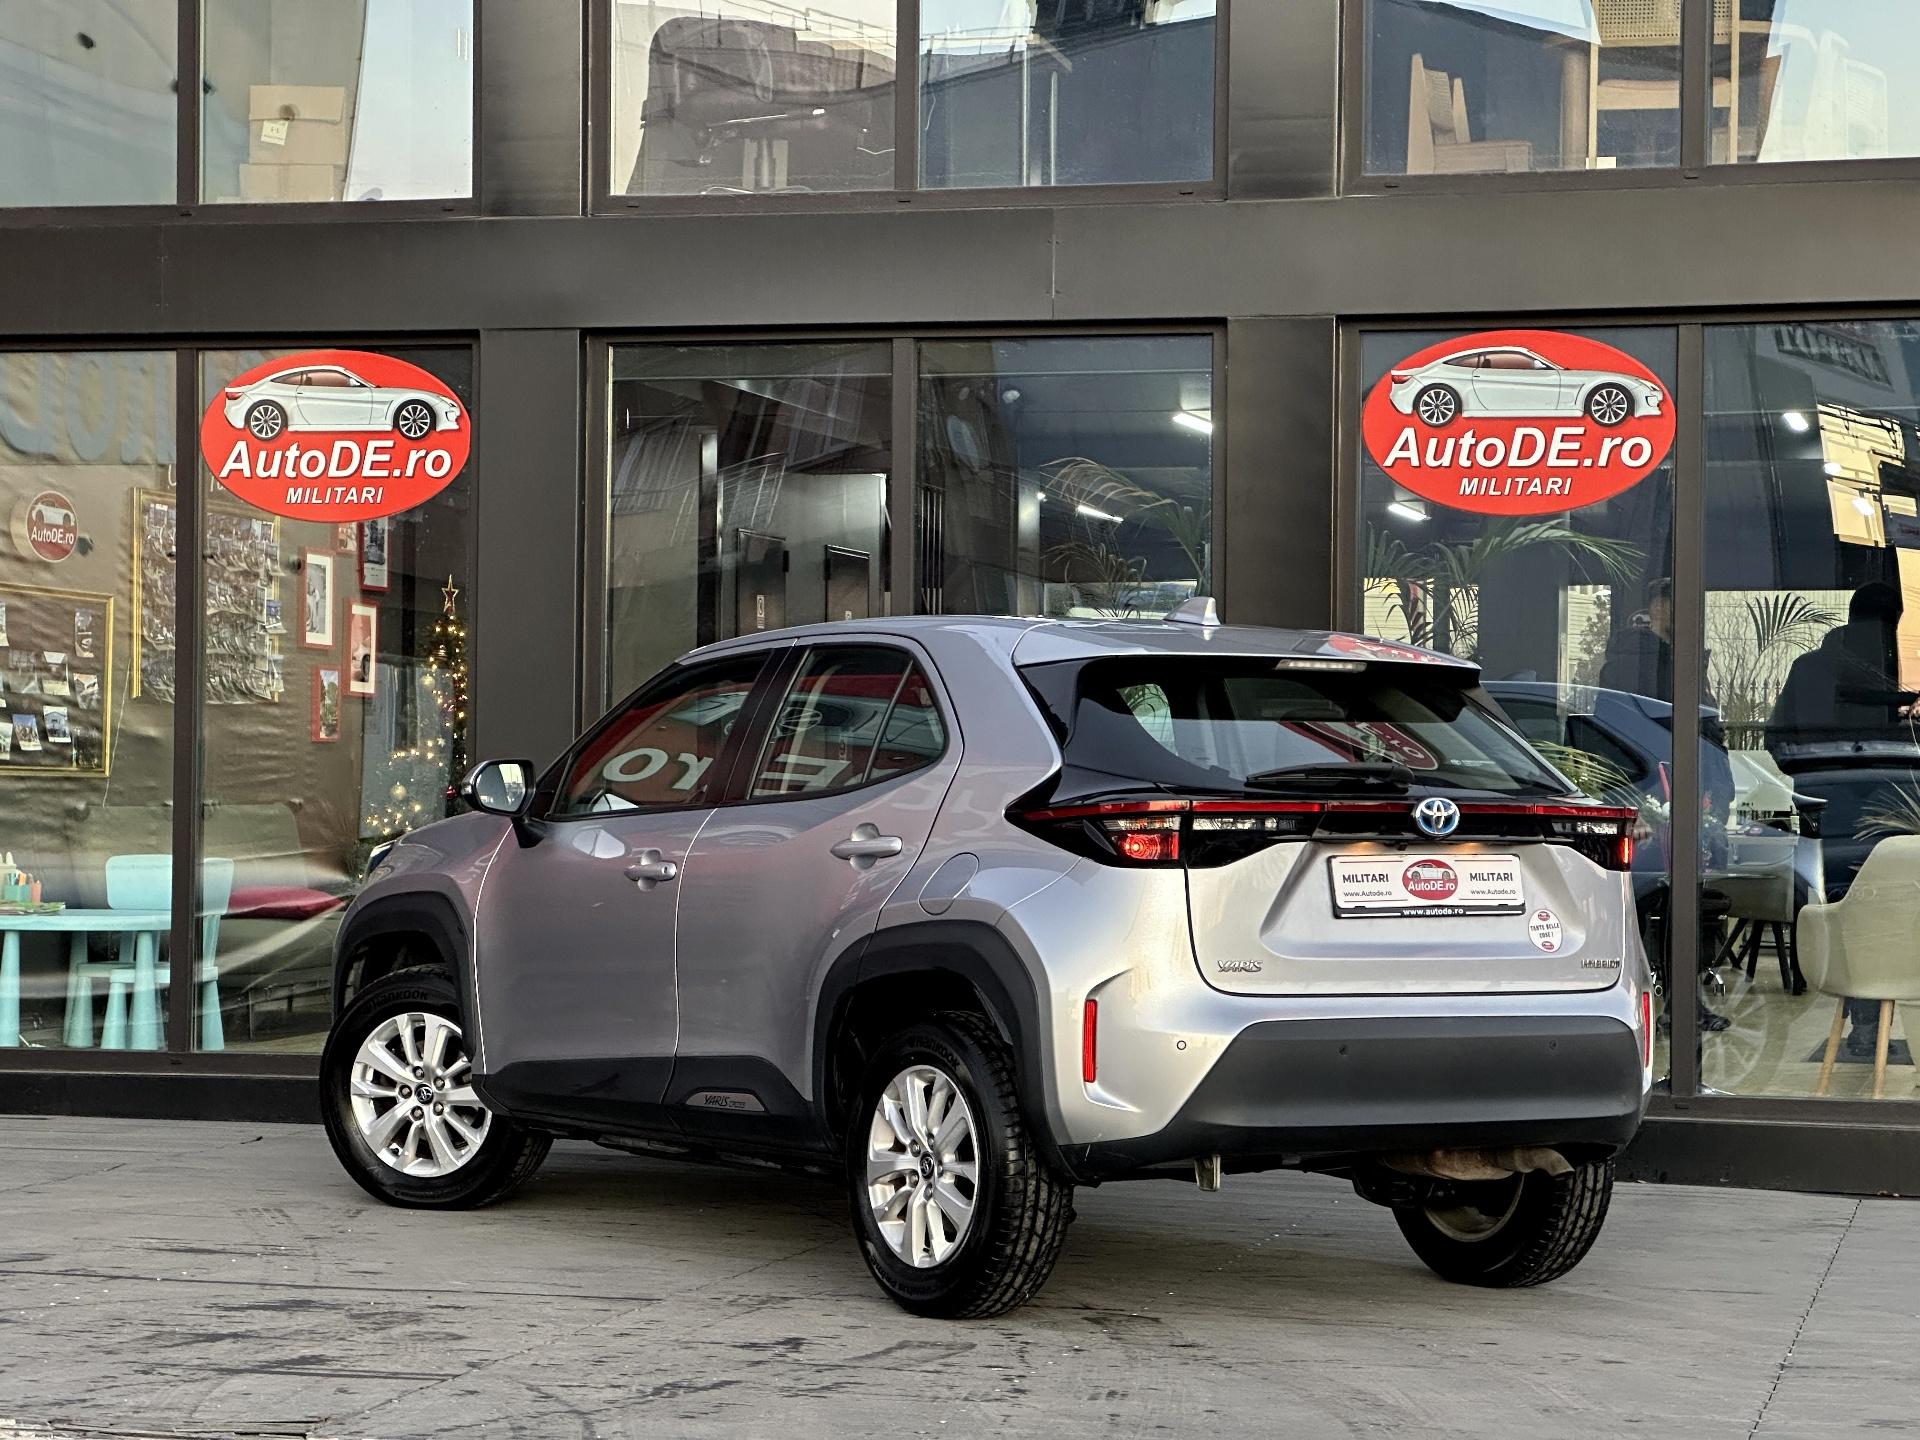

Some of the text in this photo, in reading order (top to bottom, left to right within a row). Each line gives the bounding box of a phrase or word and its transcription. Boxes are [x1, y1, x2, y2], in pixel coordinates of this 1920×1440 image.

[1383, 427, 1652, 468] AutoDE.ro
[219, 440, 452, 478] AutoDE.ro
[1459, 477, 1572, 496] MILITARI
[285, 486, 384, 504] MILITARI
[31, 526, 75, 545] AutoDE.ro
[1342, 873, 1390, 884] MILITARI
[1469, 872, 1514, 883] MILITARI
[1408, 880, 1456, 892] AutoDE.ro
[1470, 888, 1517, 896] www.Autode.ro
[1343, 889, 1393, 898] www.Autode.ro
[1402, 907, 1464, 916] www.autode.ro
